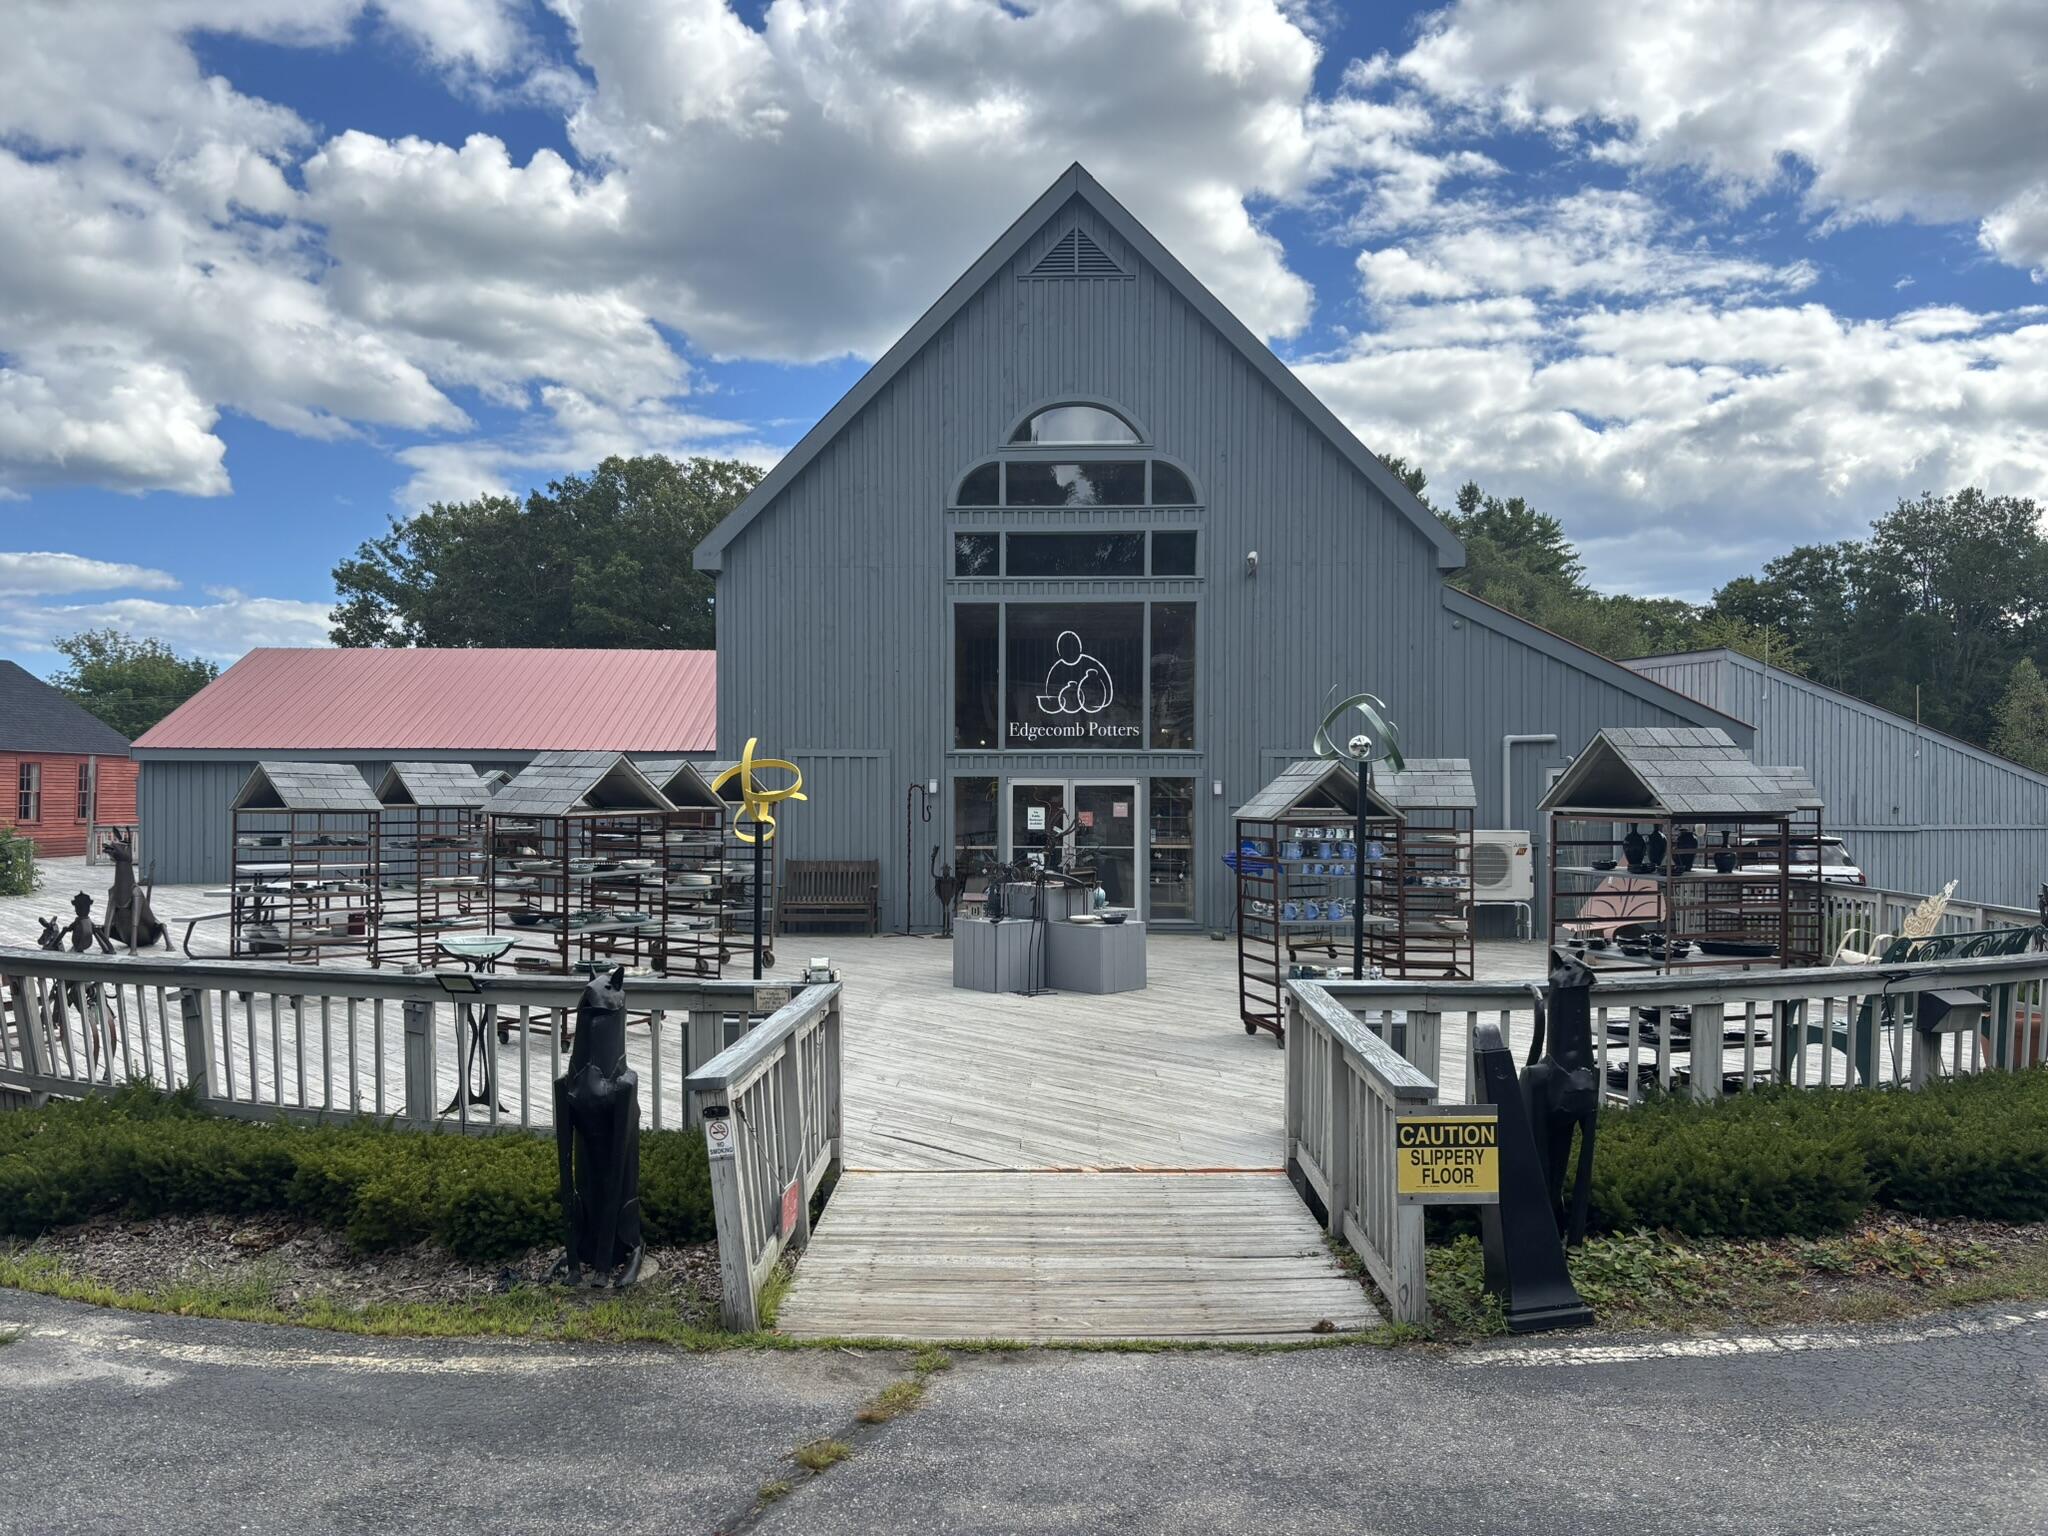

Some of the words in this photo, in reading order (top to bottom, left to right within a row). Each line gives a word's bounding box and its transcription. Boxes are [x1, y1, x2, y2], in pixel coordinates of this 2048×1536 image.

[1009, 721, 1085, 741] Edgecomb
[1088, 721, 1140, 737] Potters
[1400, 1125, 1495, 1145] CAUTION
[1411, 1148, 1485, 1166] SLIPPERY
[1422, 1167, 1474, 1185] FLOOR
